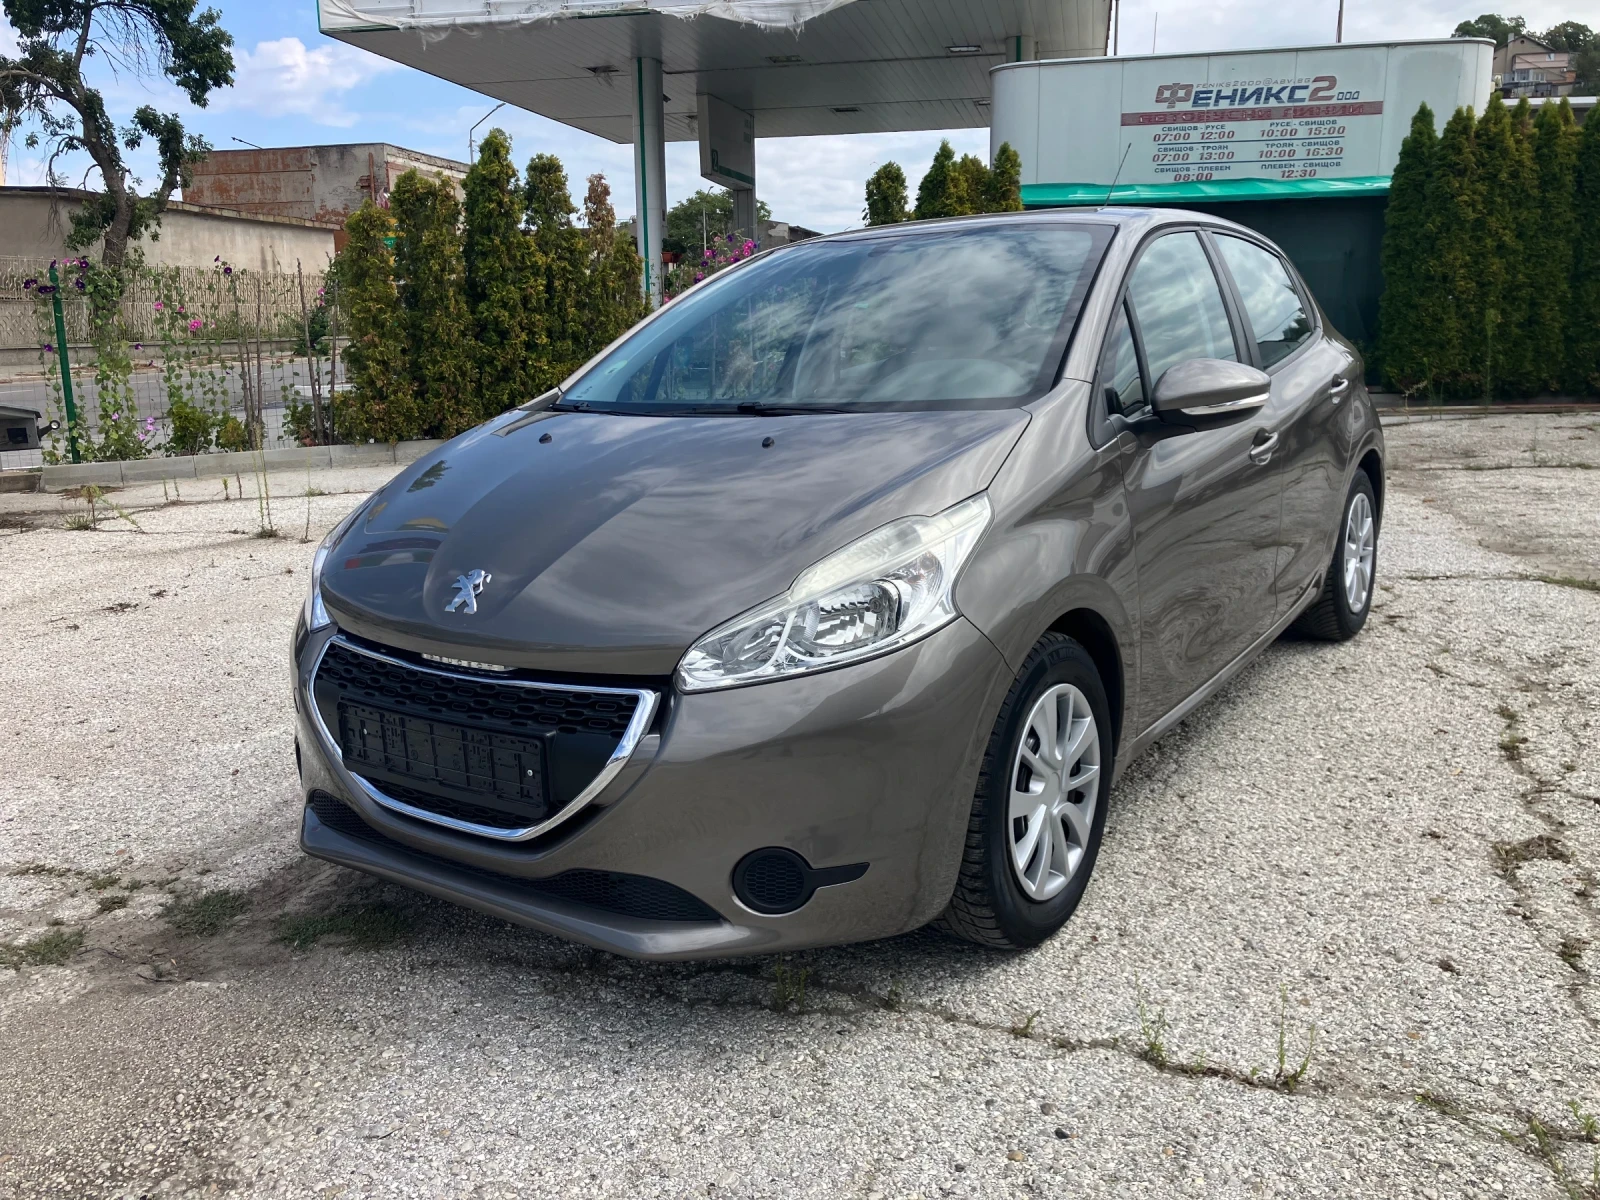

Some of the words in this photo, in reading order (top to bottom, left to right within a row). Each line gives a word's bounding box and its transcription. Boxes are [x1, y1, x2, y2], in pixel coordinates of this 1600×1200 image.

[1153, 132, 1190, 142] 07:00
[1200, 130, 1235, 140] 12:00
[1260, 128, 1298, 138] 10:00
[1308, 126, 1346, 136] 15:00
[1152, 153, 1190, 162] 07:00
[1199, 151, 1235, 161] 13:00
[1259, 149, 1296, 158] 10:00
[1305, 147, 1344, 157] 16:30
[1281, 169, 1317, 178] 12:30
